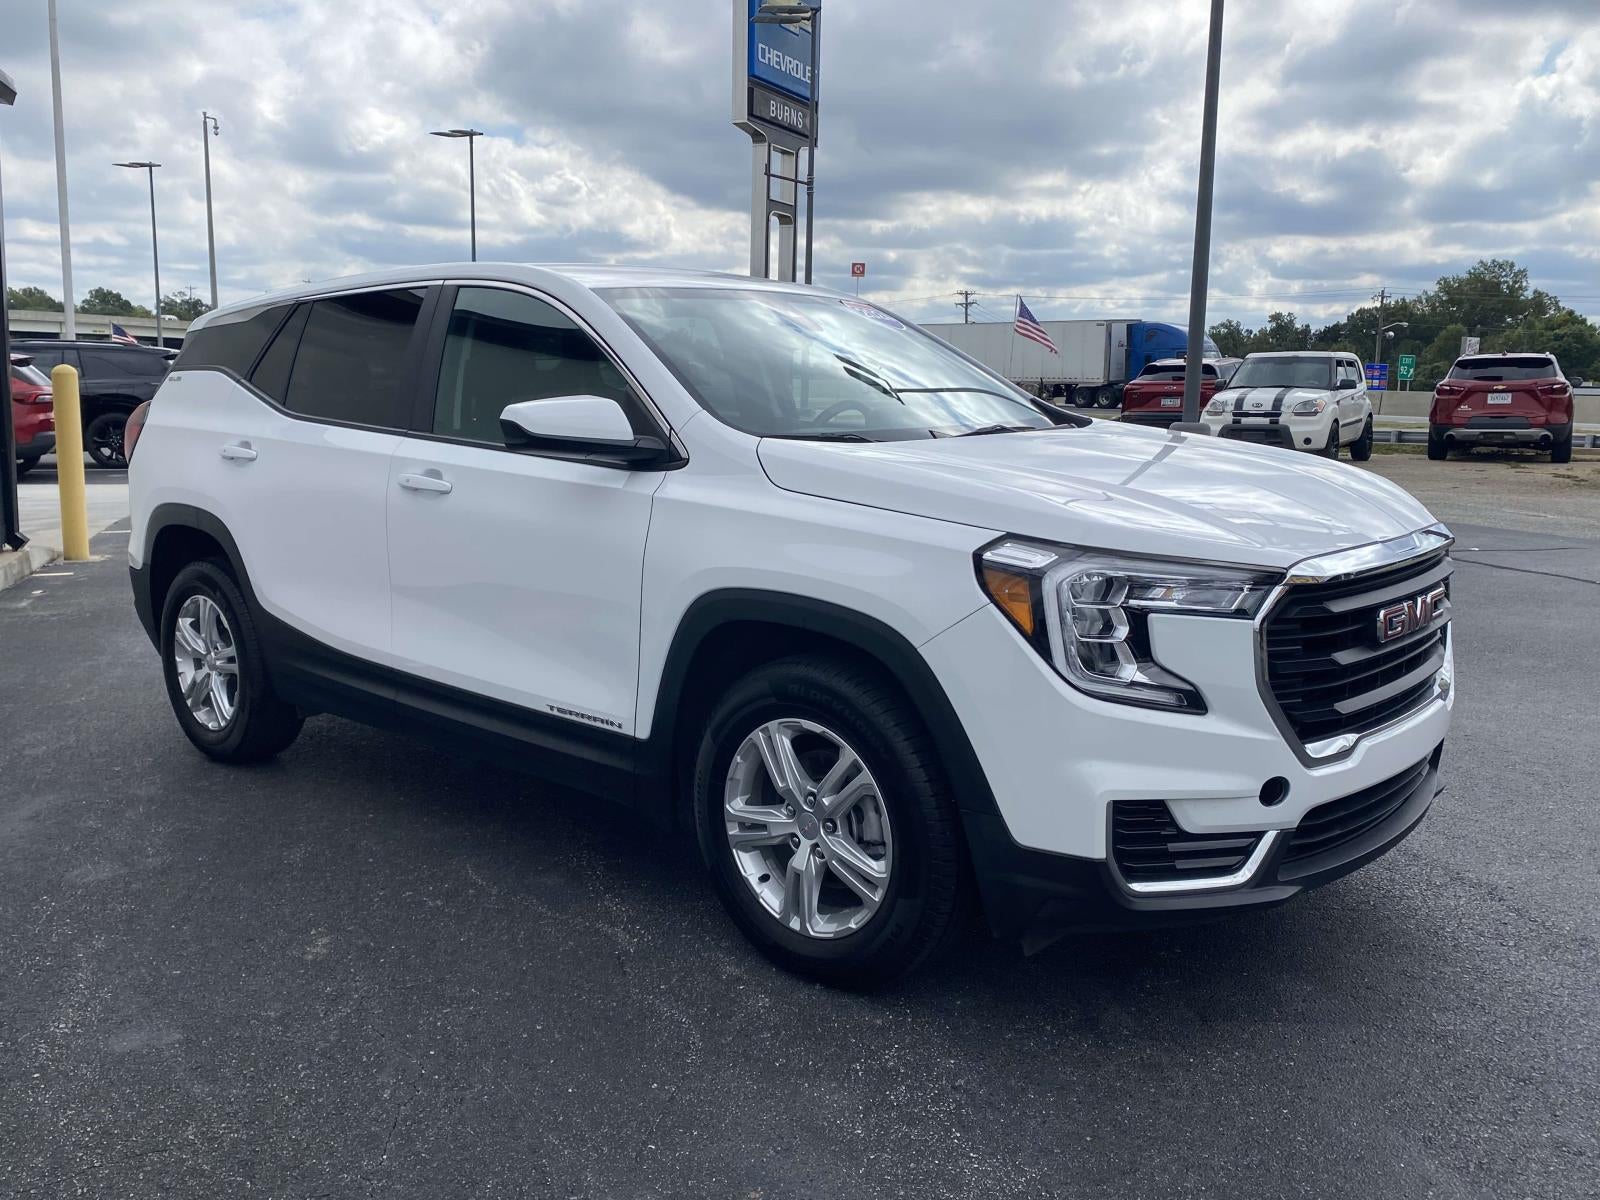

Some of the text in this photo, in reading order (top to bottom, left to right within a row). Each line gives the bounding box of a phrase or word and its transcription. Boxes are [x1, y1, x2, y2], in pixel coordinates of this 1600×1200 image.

[758, 43, 812, 83] CHEVROLE
[770, 100, 803, 128] BURNS
[1400, 366, 1408, 375] 92
[1377, 587, 1446, 643] GMC
[545, 704, 623, 729] TERRAIN
